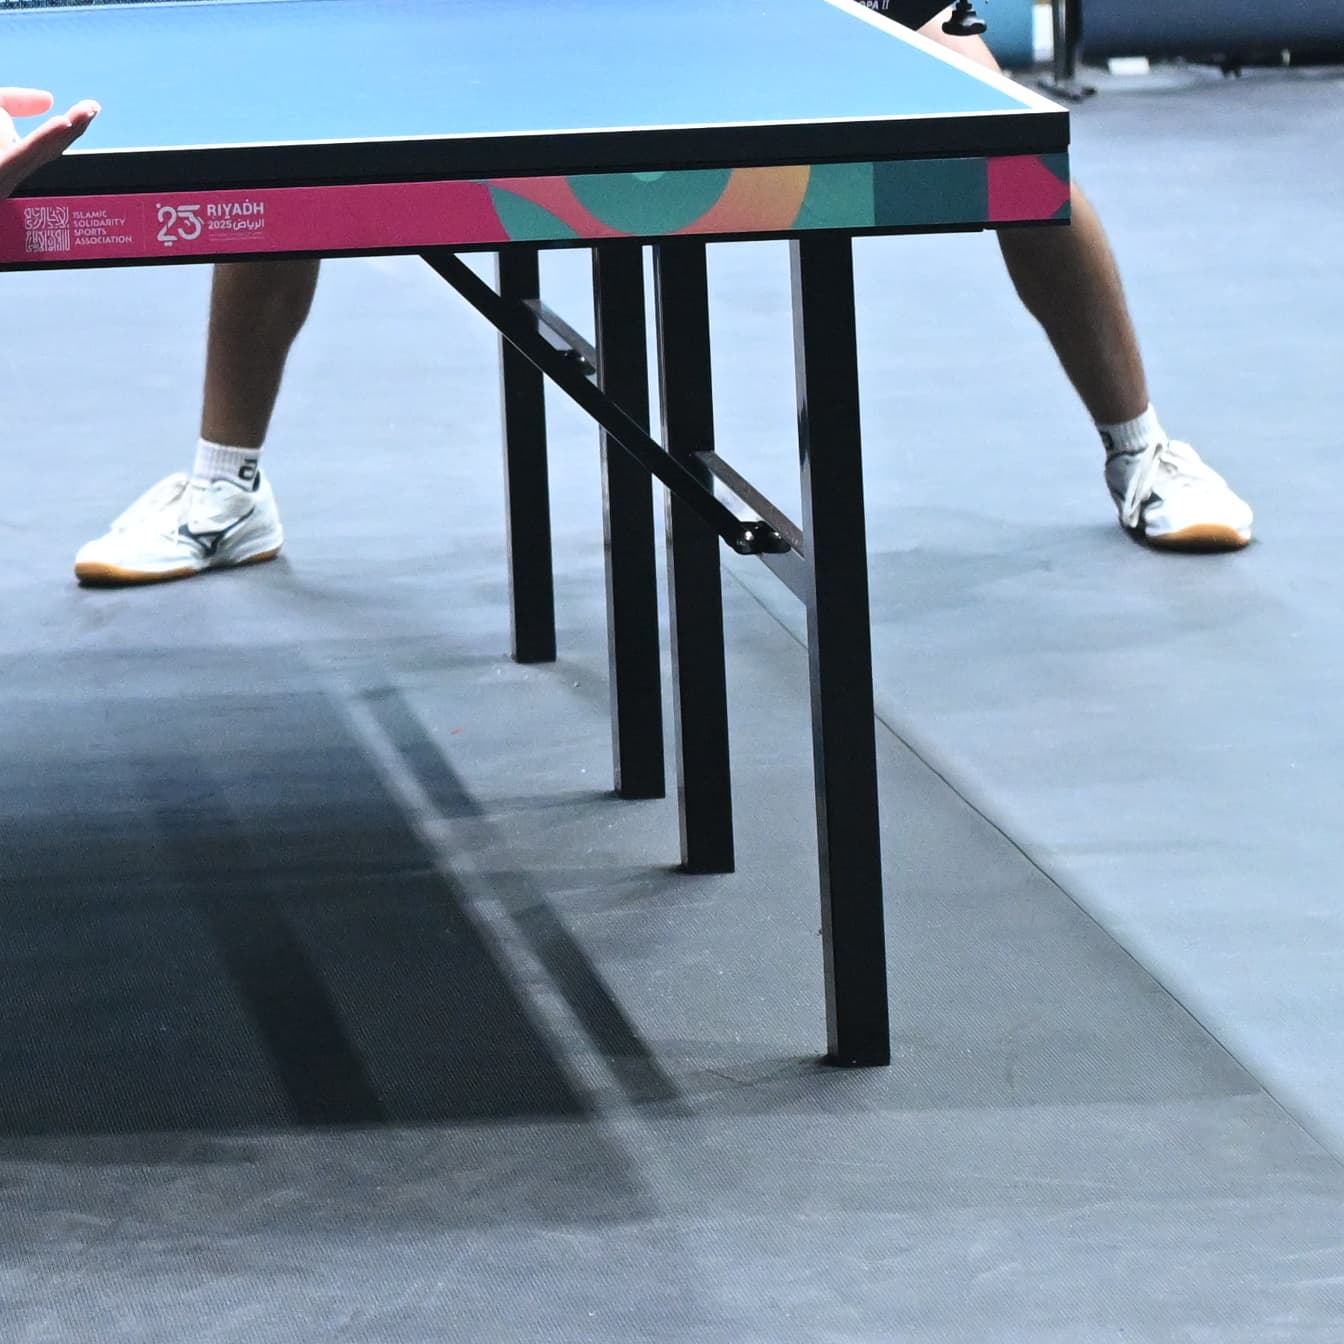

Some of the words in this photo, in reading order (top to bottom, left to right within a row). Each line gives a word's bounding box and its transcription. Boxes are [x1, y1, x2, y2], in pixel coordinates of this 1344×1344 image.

[73, 209, 107, 219] ISLAMIC
[207, 200, 264, 218] RIYADH
[73, 218, 126, 228] SOLIDARITY
[208, 220, 231, 230] 2025
[74, 227, 107, 237] SPORTS
[75, 235, 132, 245] ASSOCIATION
